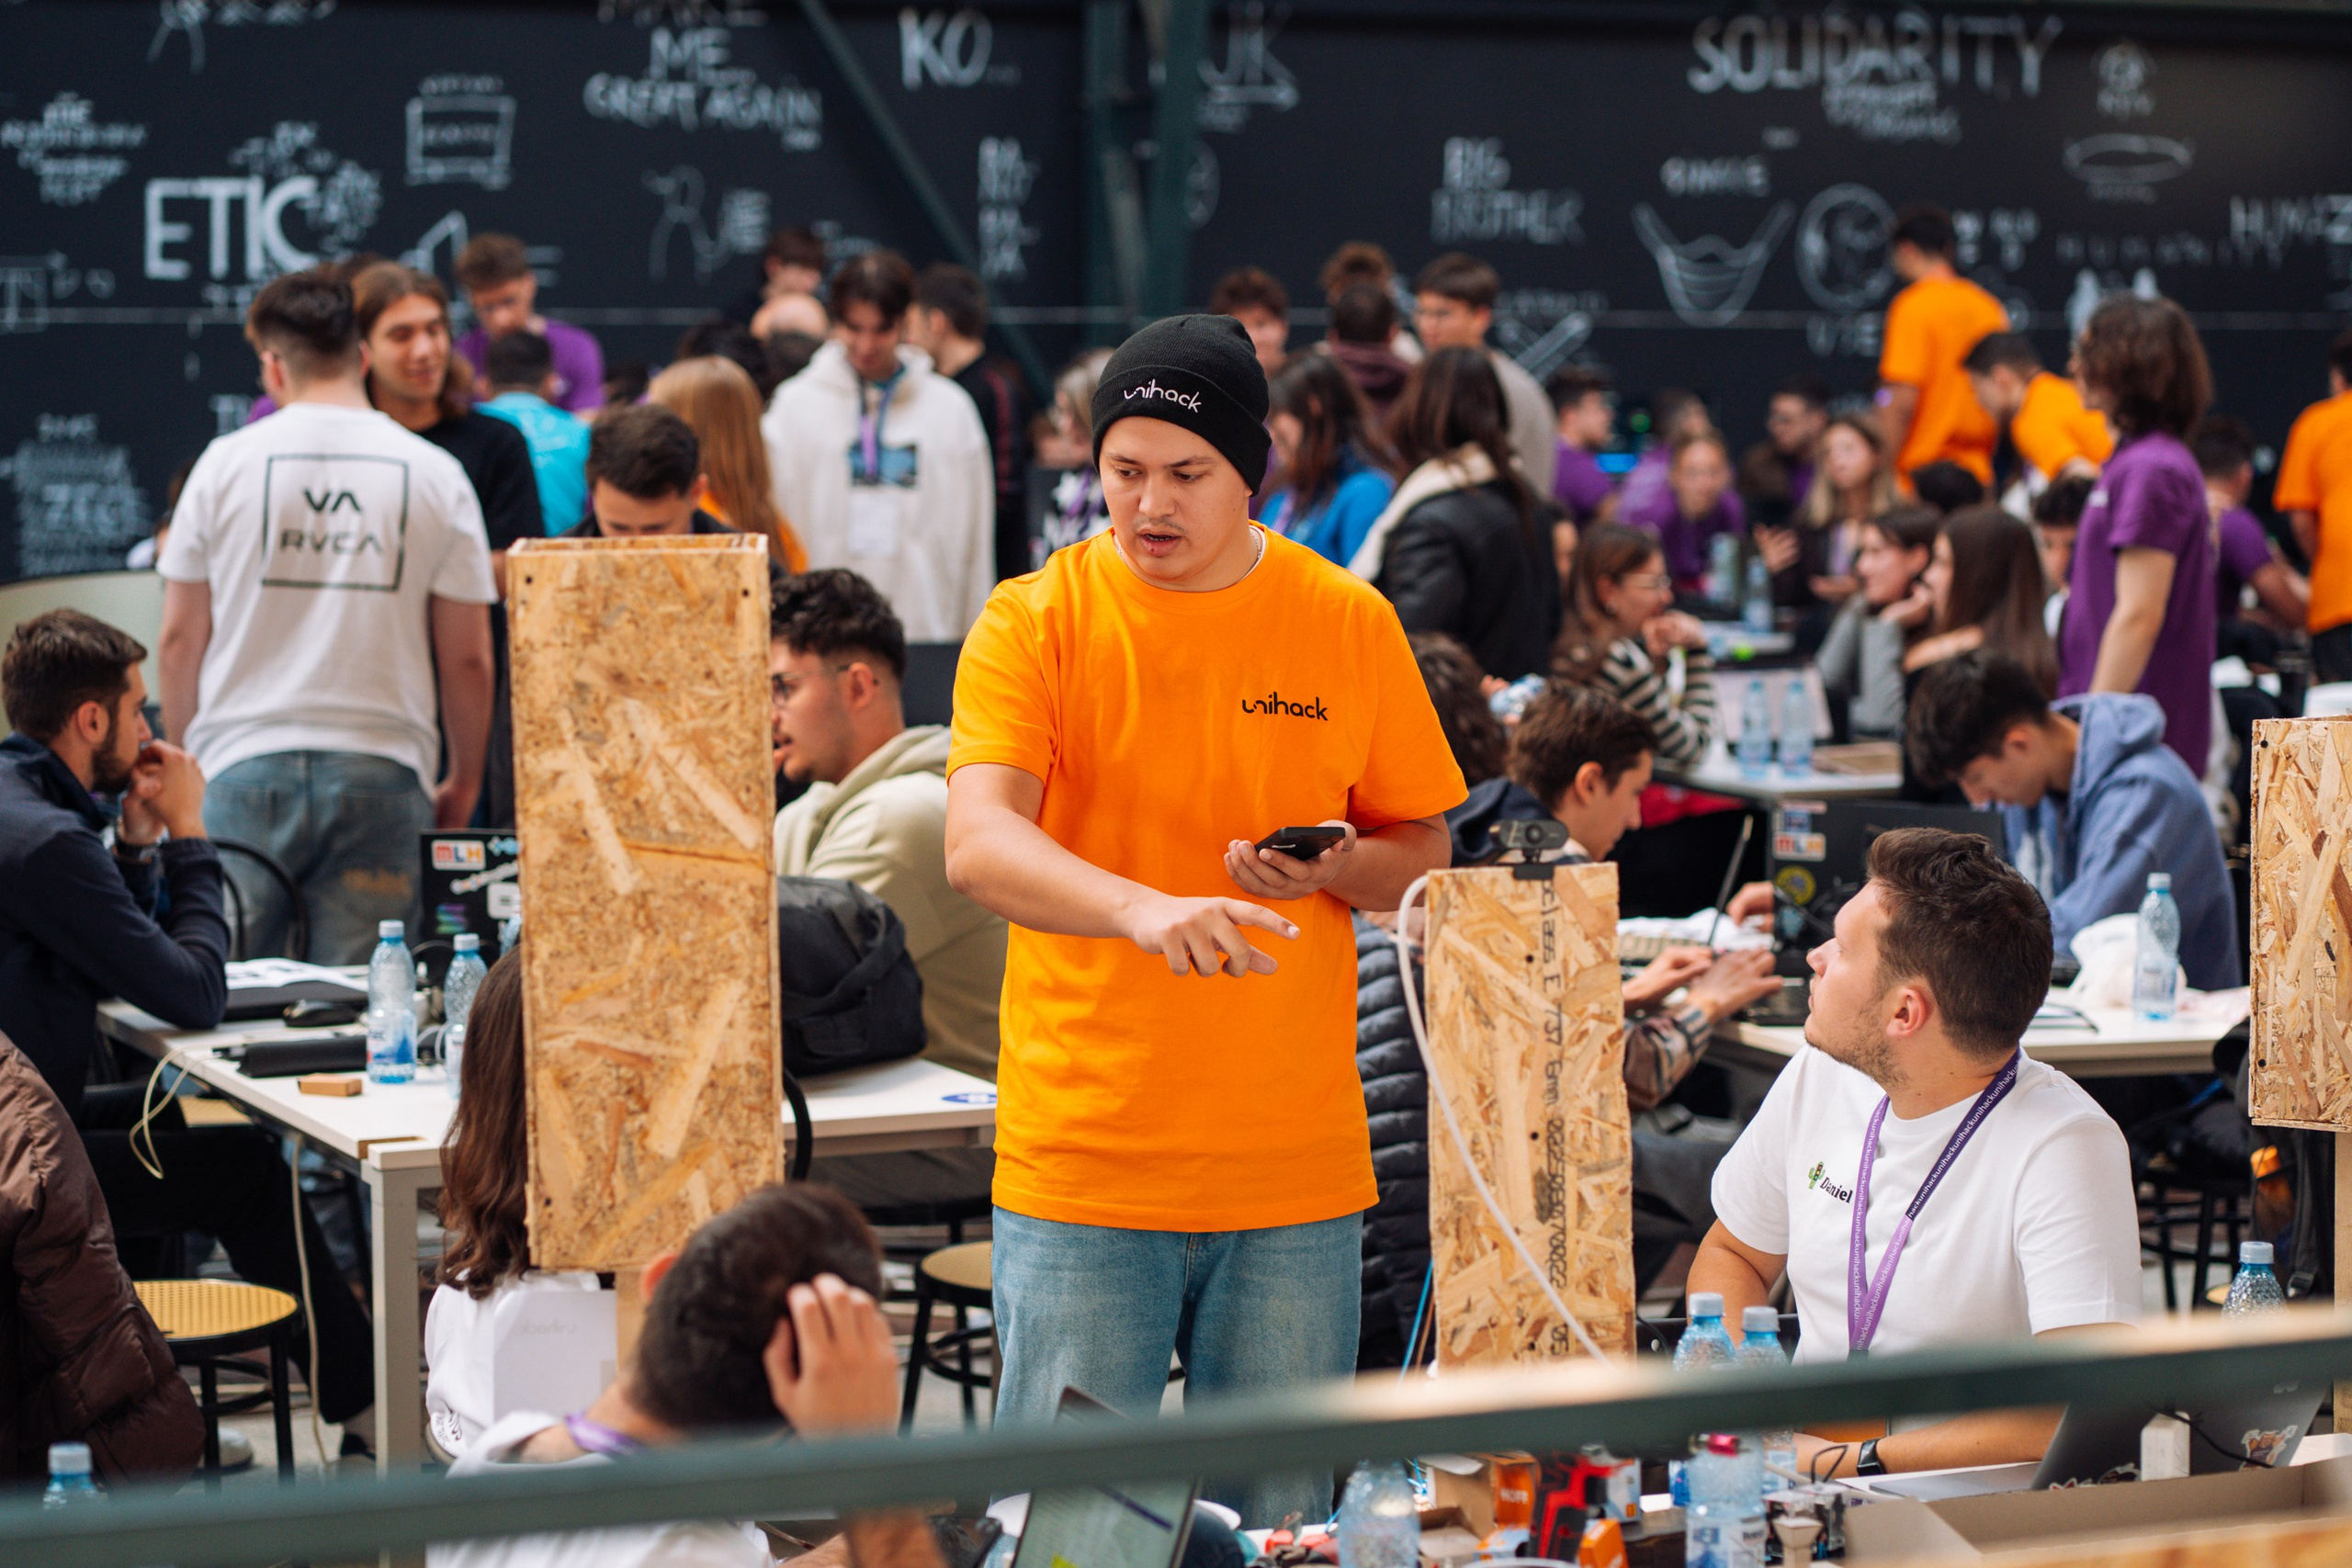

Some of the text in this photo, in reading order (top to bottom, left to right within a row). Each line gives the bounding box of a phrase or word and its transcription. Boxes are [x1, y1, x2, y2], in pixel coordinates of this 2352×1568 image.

[1687, 9, 2064, 95] SOLIDARITY
[144, 175, 319, 278] ETIC
[1124, 378, 1202, 413] unihack
[303, 487, 363, 513] VA
[280, 530, 383, 553] RVCA
[1241, 691, 1329, 721] unihack
[1820, 1177, 1853, 1203] Daniel
